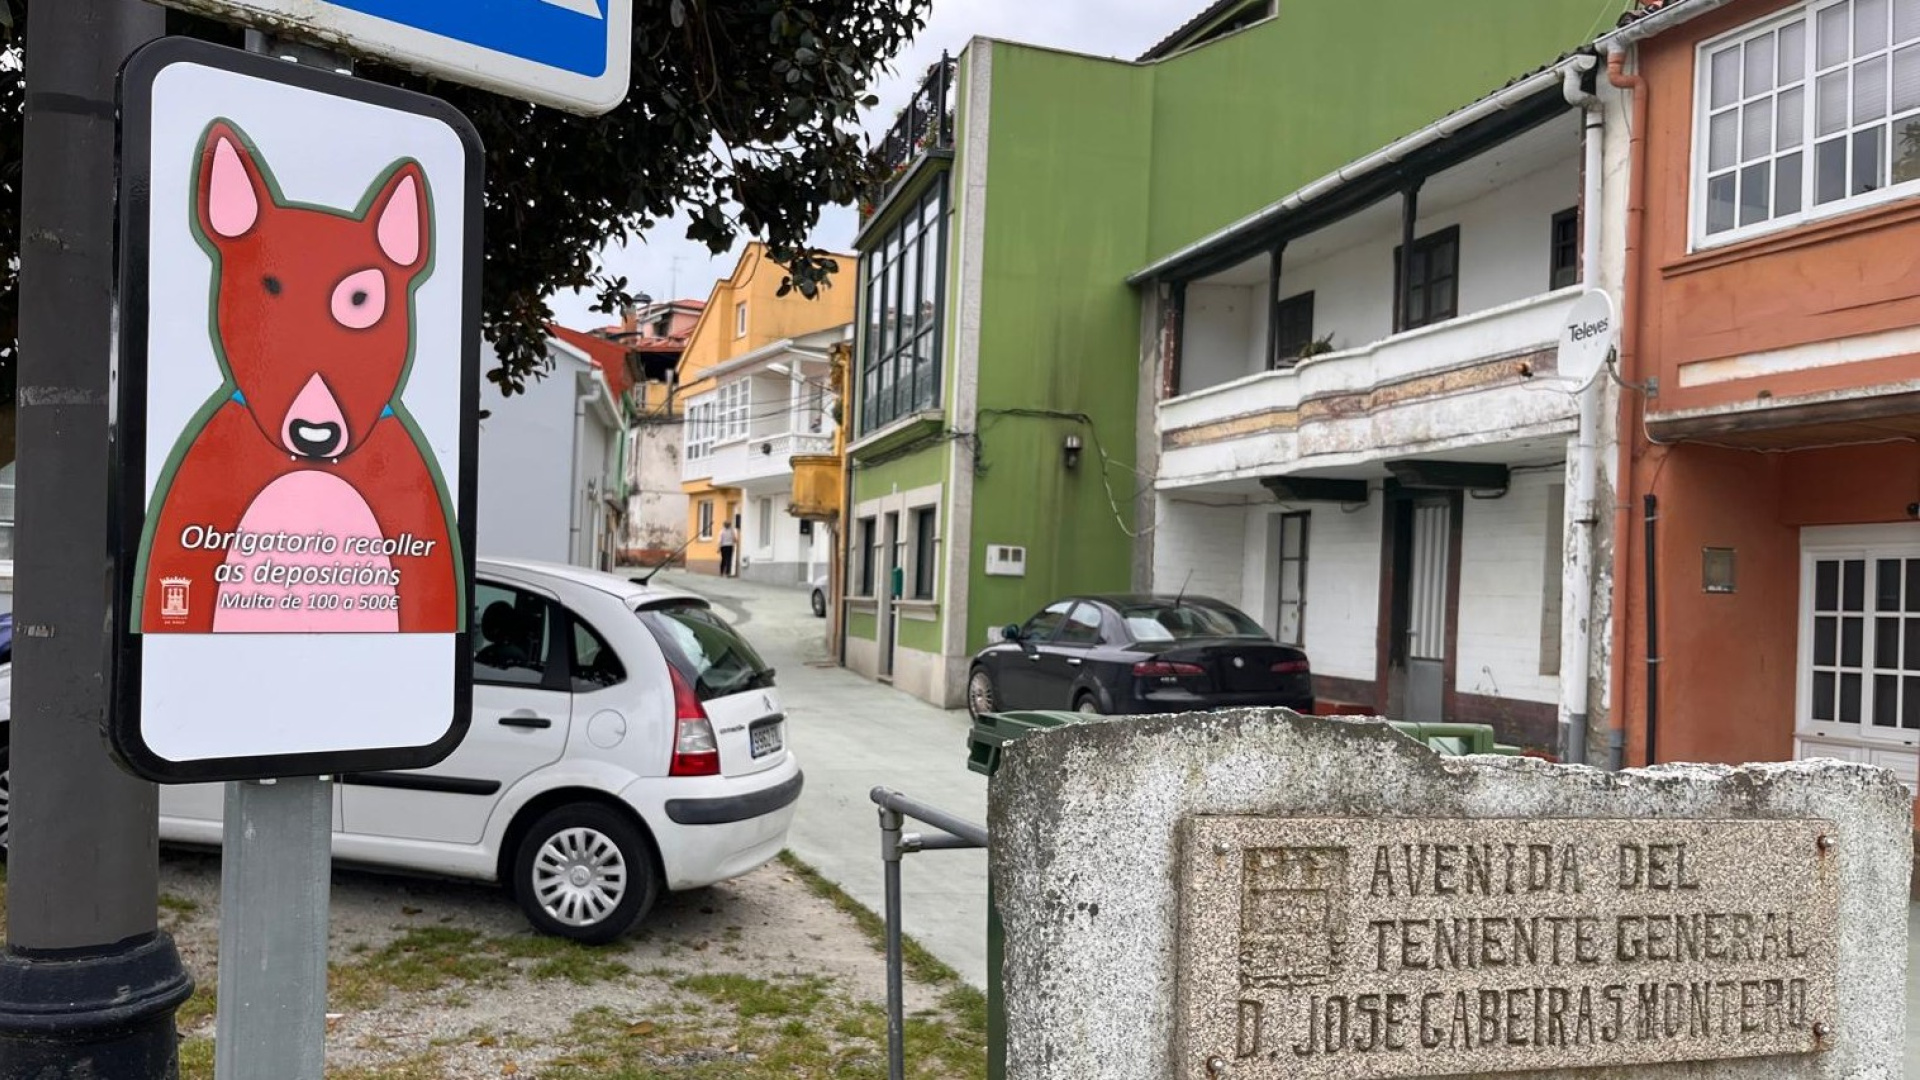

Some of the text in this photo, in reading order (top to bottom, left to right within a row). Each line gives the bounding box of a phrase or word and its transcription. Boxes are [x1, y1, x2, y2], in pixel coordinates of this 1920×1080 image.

[181, 525, 436, 557] Obrigatorio recoller
[214, 559, 401, 588] as deposicións
[220, 593, 400, 610] Multa de 100 a 500€
[1371, 843, 1699, 897] AVENIDA DEL
[1369, 912, 1808, 971] TENIENTE GENERAL
[1237, 999, 1278, 1059] D.
[1292, 993, 1407, 1056] JOSE
[1636, 978, 1807, 1041] MONTERO
